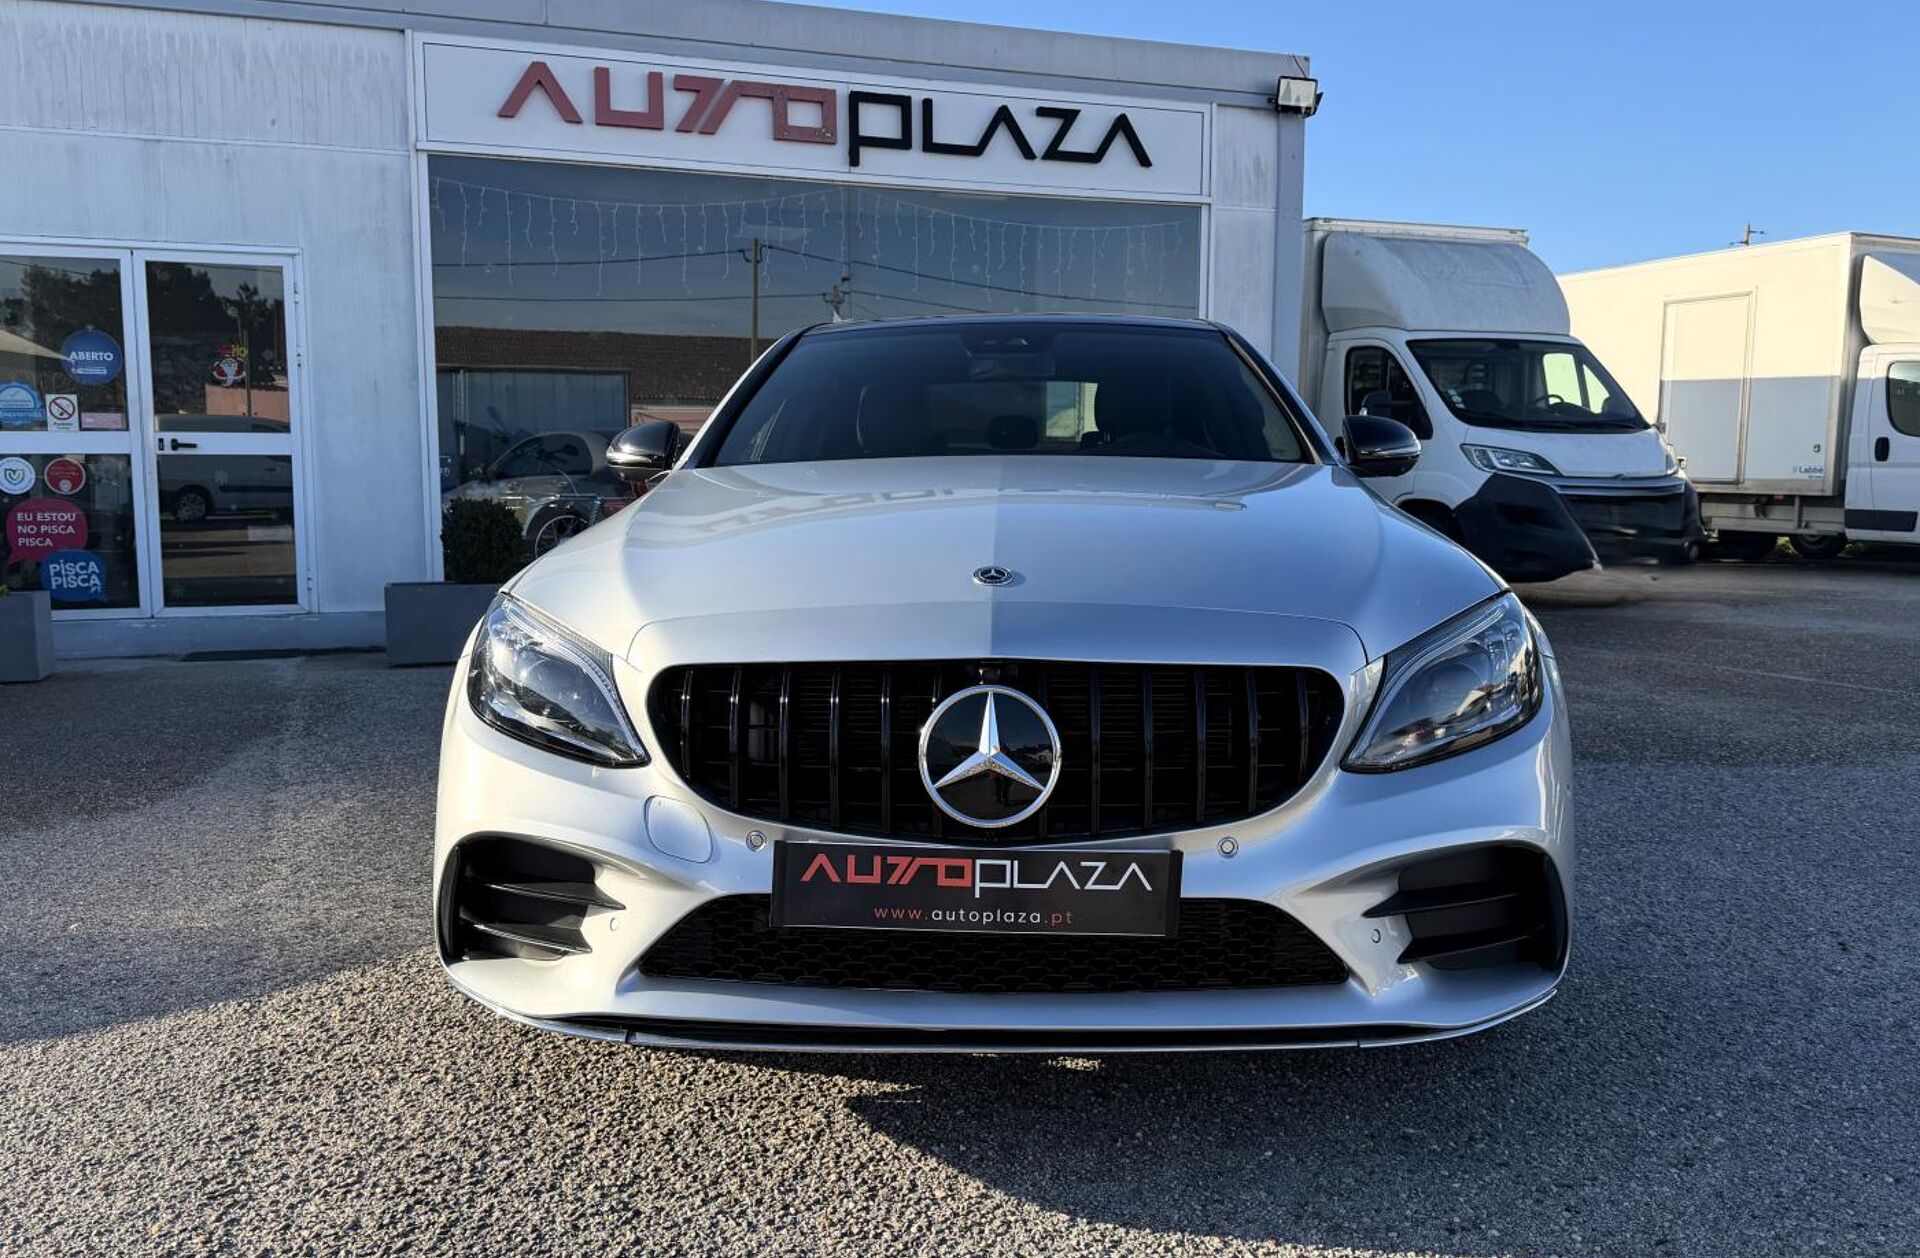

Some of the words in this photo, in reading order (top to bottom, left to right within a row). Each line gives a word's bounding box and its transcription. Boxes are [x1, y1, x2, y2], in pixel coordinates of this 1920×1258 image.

[69, 350, 114, 361] ABERTO
[16, 512, 33, 522] EU
[36, 512, 76, 522] ESTOU
[17, 525, 38, 534] NO
[40, 525, 75, 535] PISCA
[18, 537, 53, 547] PISCA
[874, 906, 1073, 928] www.autoplaza.pt
